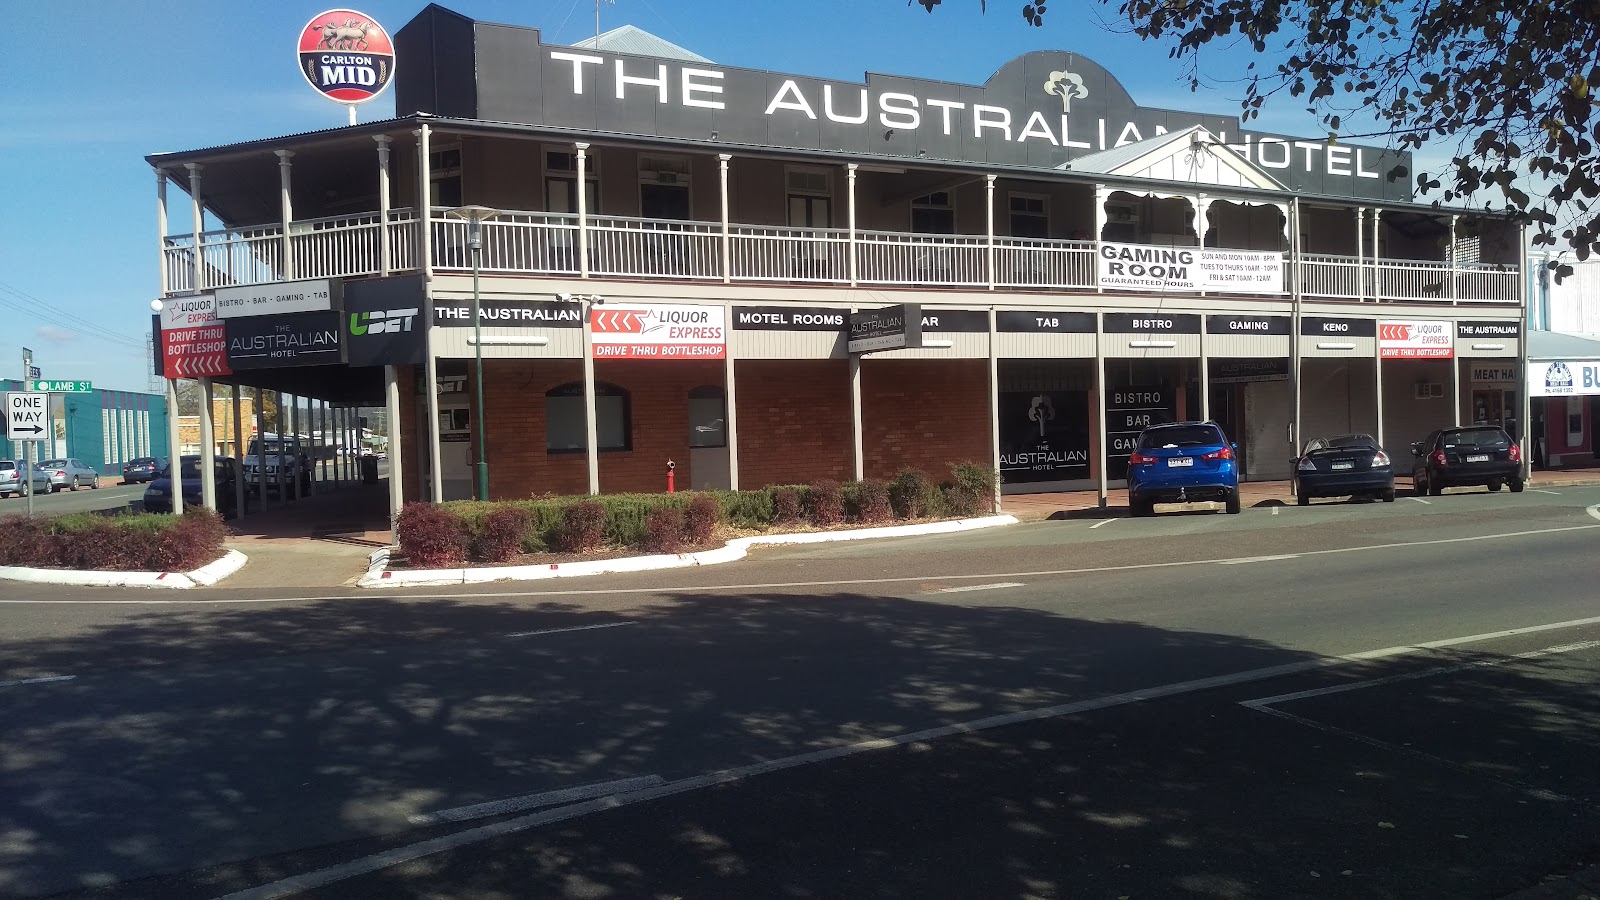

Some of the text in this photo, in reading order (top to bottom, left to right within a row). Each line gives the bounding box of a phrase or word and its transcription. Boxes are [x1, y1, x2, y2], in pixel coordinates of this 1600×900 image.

[321, 55, 372, 66] CARLTON
[321, 65, 376, 87] MID
[551, 51, 1379, 179] THE AUSTRALIA HOTEL
[1101, 245, 1194, 265] GAMING
[1108, 261, 1188, 279] ROOM
[1101, 277, 1162, 286] GUARANTEED
[1164, 280, 1194, 288] HOURS
[218, 298, 243, 307] BISTRO
[252, 297, 267, 305] BAR
[276, 293, 304, 303] GAMING
[314, 291, 328, 299] TAB
[181, 300, 211, 312] LIQUOR
[188, 312, 216, 323] EXPRES
[435, 307, 581, 321] THE AUSTRALIAN
[659, 310, 709, 324] LIQUOR
[739, 313, 843, 326] MOTEL ROOMS
[350, 308, 419, 336] UBET
[851, 317, 902, 333] AUSTRALIAN
[921, 316, 939, 326] AR
[1036, 317, 1059, 328] TAB
[1132, 319, 1173, 329] BISTRO
[1229, 321, 1268, 330] GAMING
[669, 326, 722, 339] EXPRESS
[1323, 323, 1348, 332] KENO
[1417, 325, 1442, 334] LIQUOR
[1459, 326, 1517, 334] THE AUSTRALIAN
[169, 328, 223, 342] DRIVE THRU
[231, 330, 338, 350] AUSTRALIAN
[1421, 335, 1449, 344] EXPRESS
[168, 341, 227, 355] BOTTLESHOP
[270, 350, 297, 358] HOTEL
[596, 345, 723, 356] DRIVE THRU BOTTLESHOP
[1221, 362, 1277, 372] AUSTRALIAN
[1474, 369, 1516, 379] MEAT HA
[48, 381, 90, 391] LAMB ST
[13, 397, 41, 408] ONE
[1115, 392, 1161, 404] BISTRO
[12, 411, 43, 423] WAY
[1126, 415, 1150, 427] BAR
[1000, 450, 1087, 465] AUSTRALIAN
